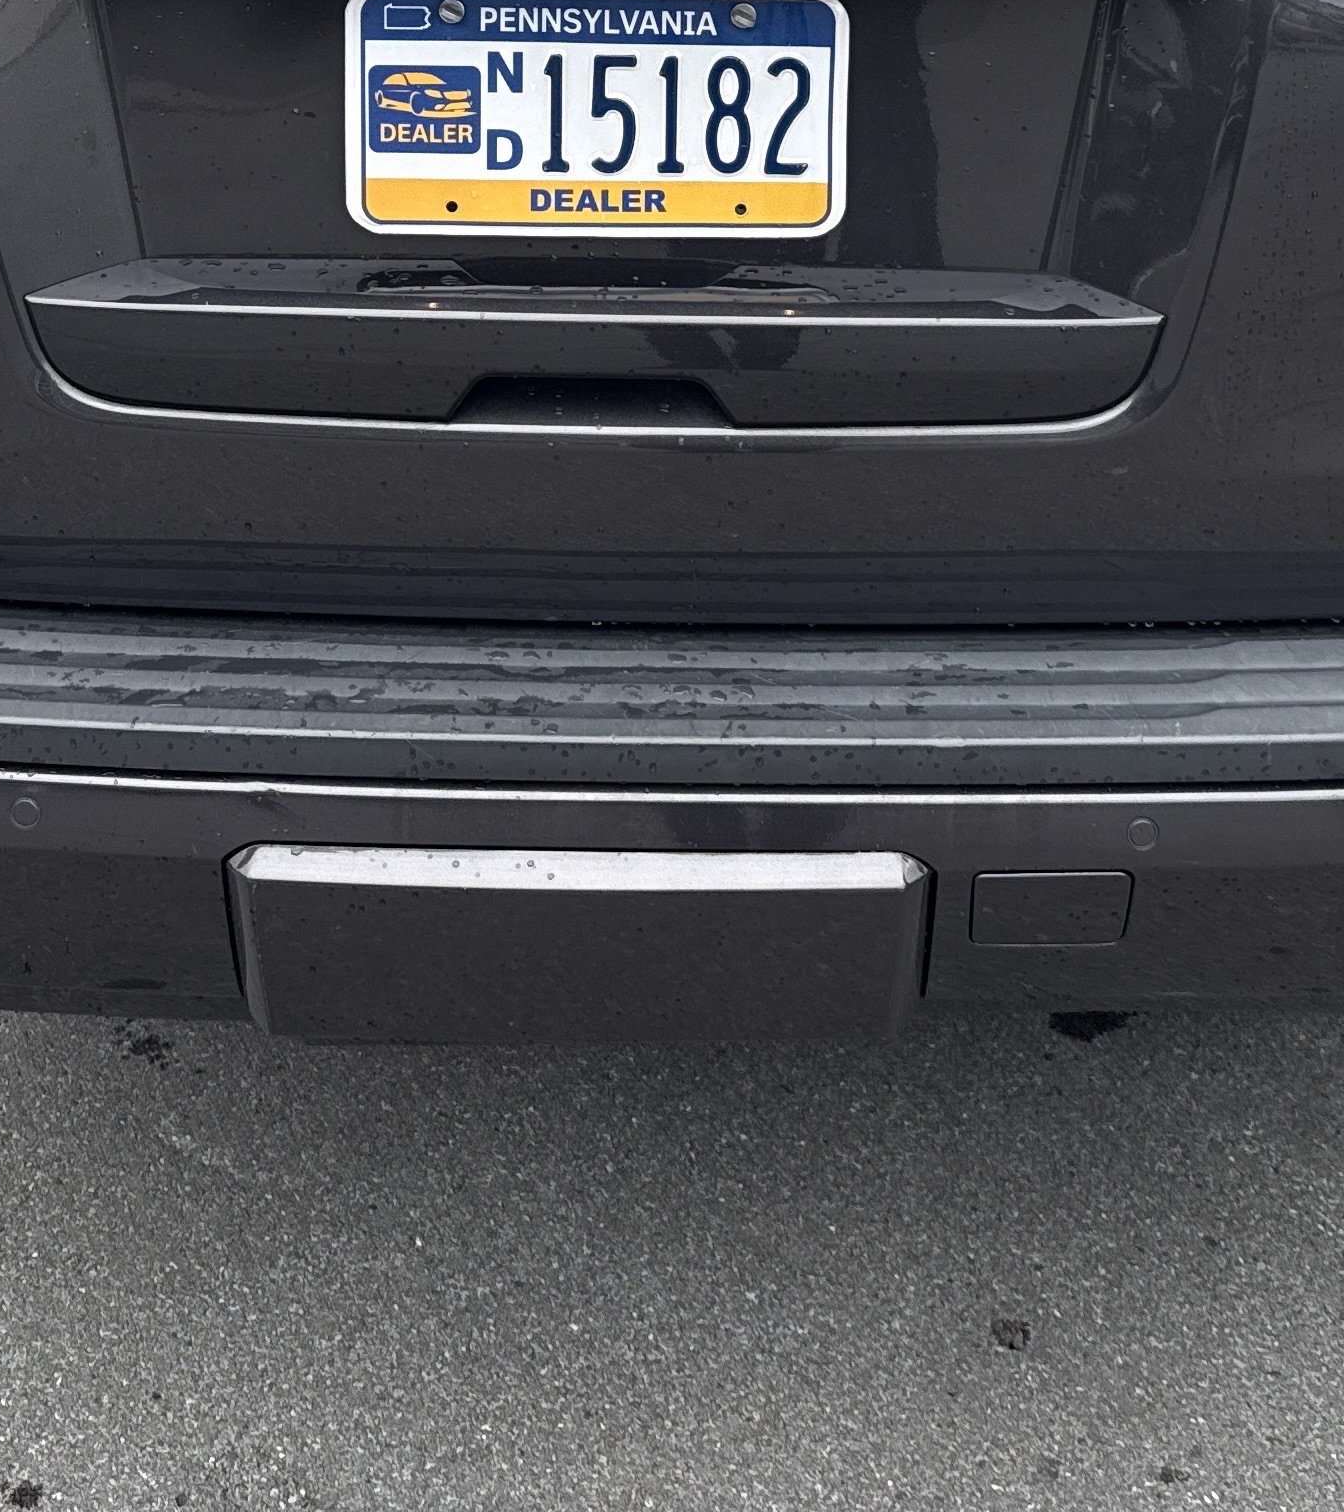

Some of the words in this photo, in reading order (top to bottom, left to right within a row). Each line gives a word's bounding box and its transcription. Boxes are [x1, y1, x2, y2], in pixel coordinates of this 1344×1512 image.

[479, 7, 718, 37] PENNSYLVANIA
[540, 53, 810, 175] 15182
[379, 123, 474, 144] DEALER
[529, 189, 667, 213] DEALER
